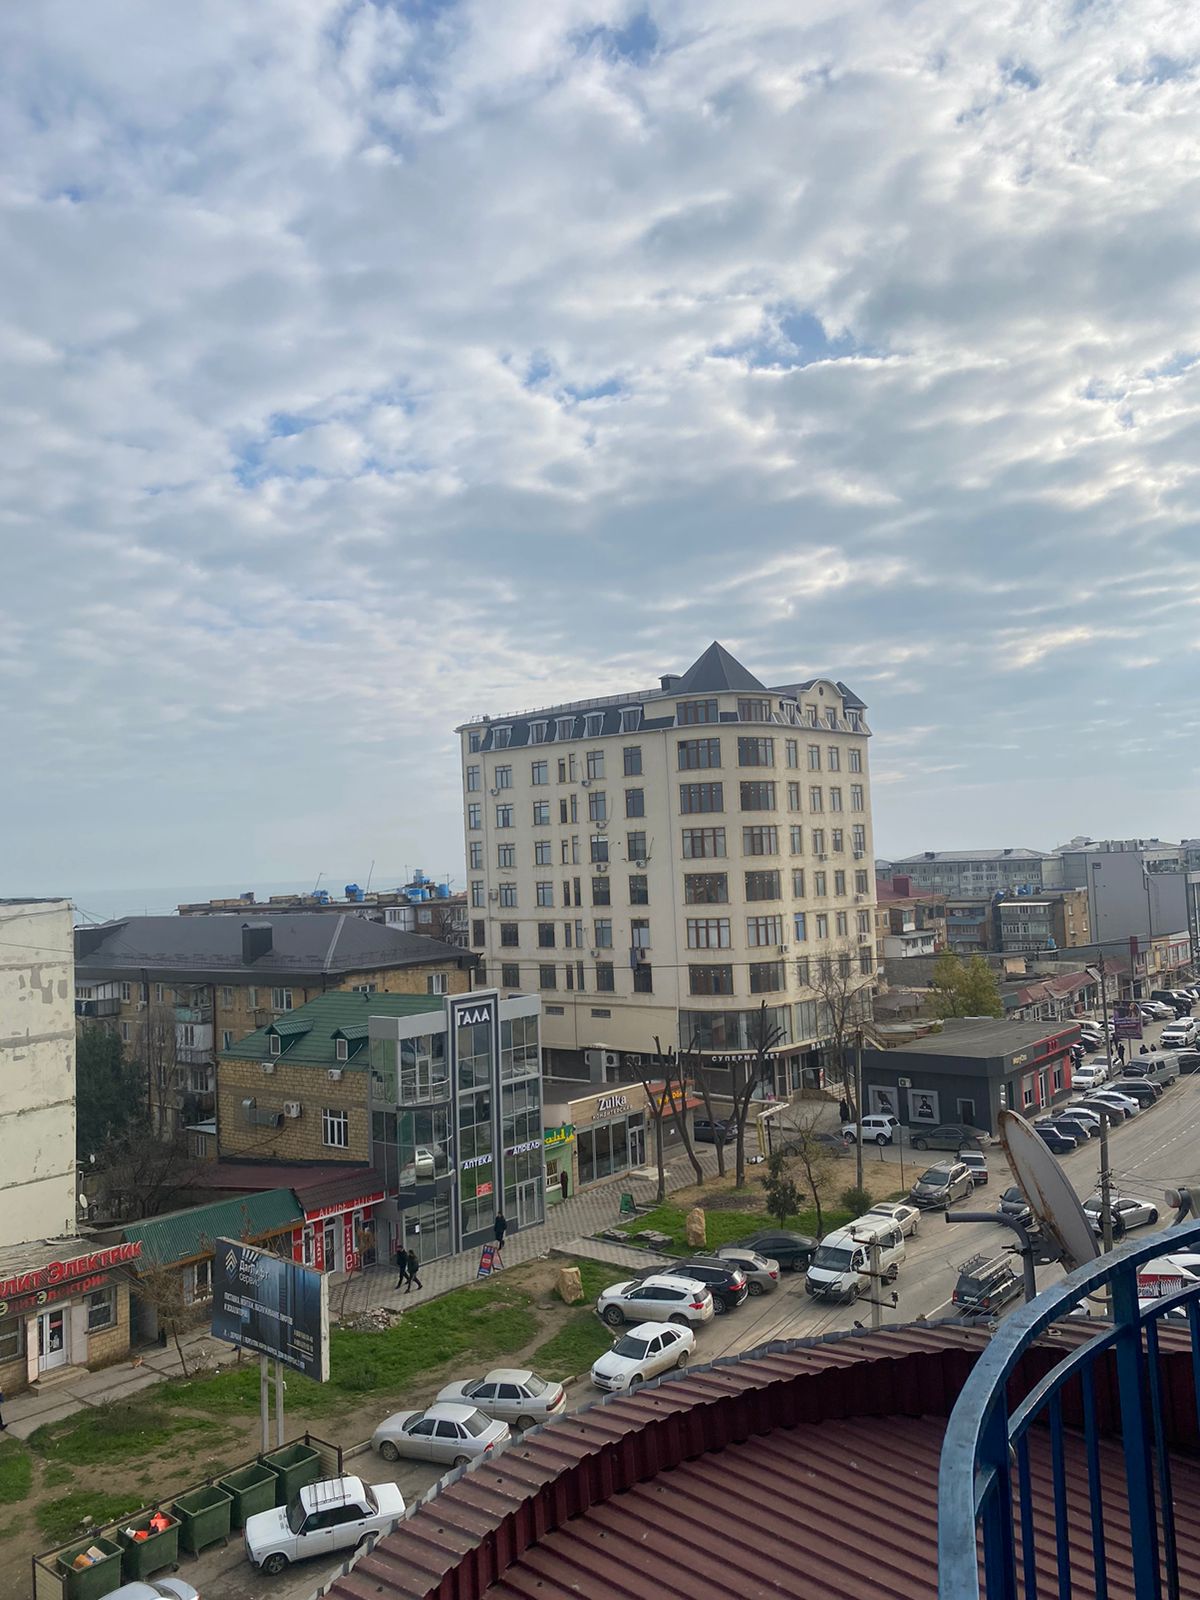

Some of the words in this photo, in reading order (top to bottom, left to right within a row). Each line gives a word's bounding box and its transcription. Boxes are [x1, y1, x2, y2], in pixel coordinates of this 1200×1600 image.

[457, 1008, 490, 1026] ГАЛА
[711, 1052, 781, 1063] СУПЕРМАКЕТ
[597, 1095, 627, 1112] Zulka
[463, 1155, 493, 1170] АПТЕКА
[0, 1271, 42, 1298] ЛИТ
[47, 1240, 143, 1284] ЭЛЕКТРИК
